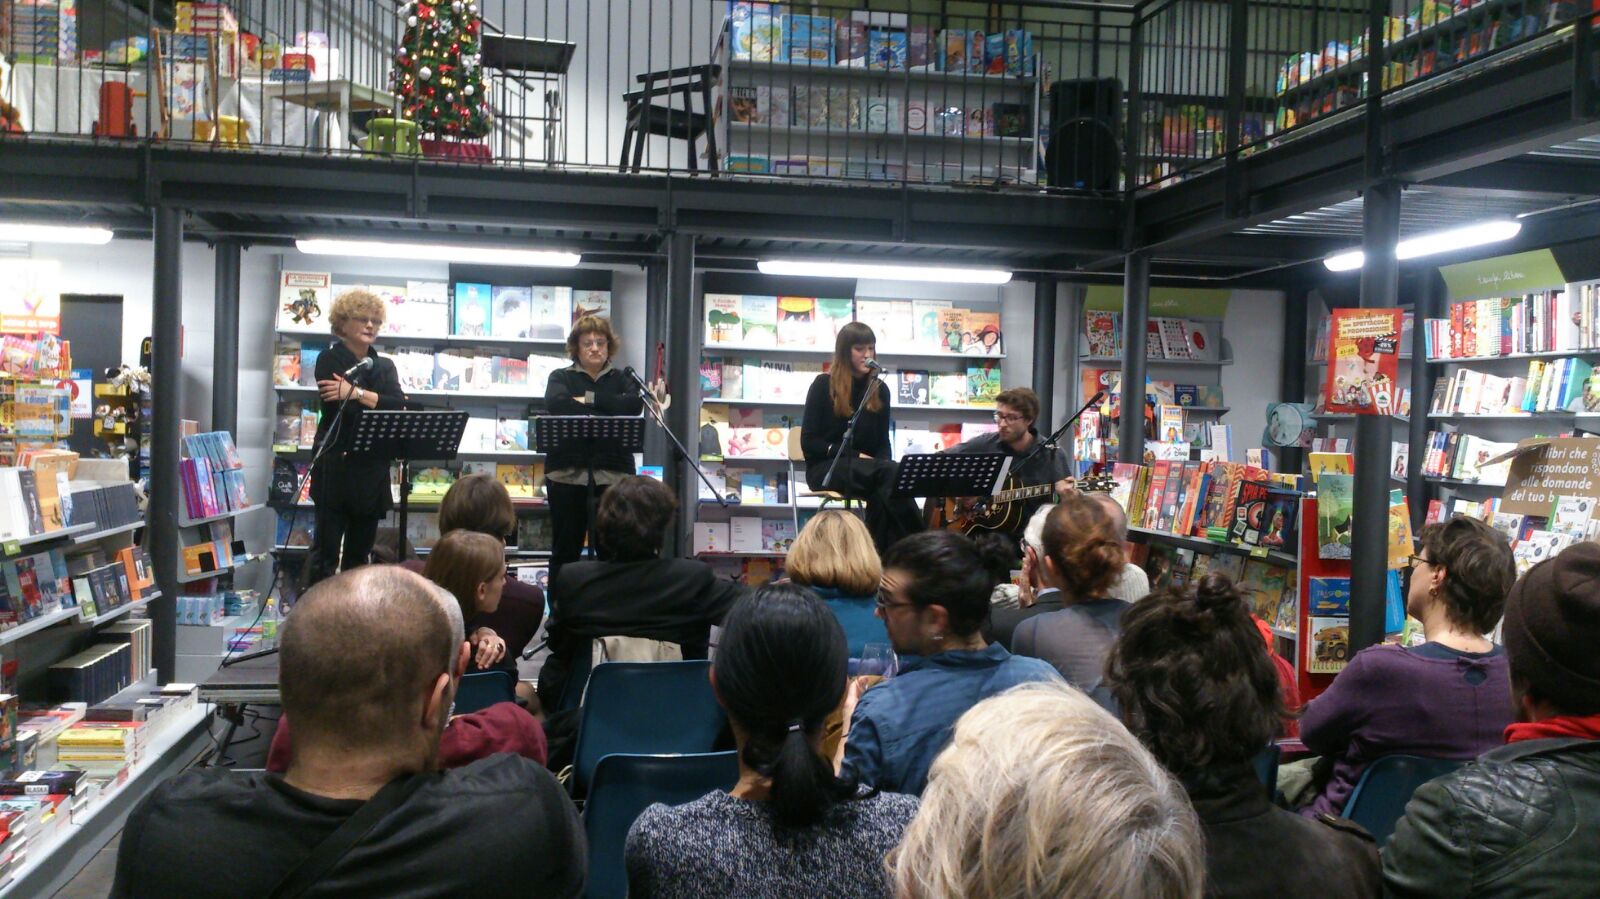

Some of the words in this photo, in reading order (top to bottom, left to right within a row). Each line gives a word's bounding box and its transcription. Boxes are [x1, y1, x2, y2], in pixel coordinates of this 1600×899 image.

[1546, 446, 1567, 459] libri
[1569, 446, 1588, 459] che
[1530, 461, 1589, 478] rispondono
[1521, 477, 1538, 488] alle
[1541, 475, 1592, 490] domande
[1511, 489, 1526, 501] del
[1528, 492, 1545, 503] tuo
[26, 785, 48, 793] ALASKA
